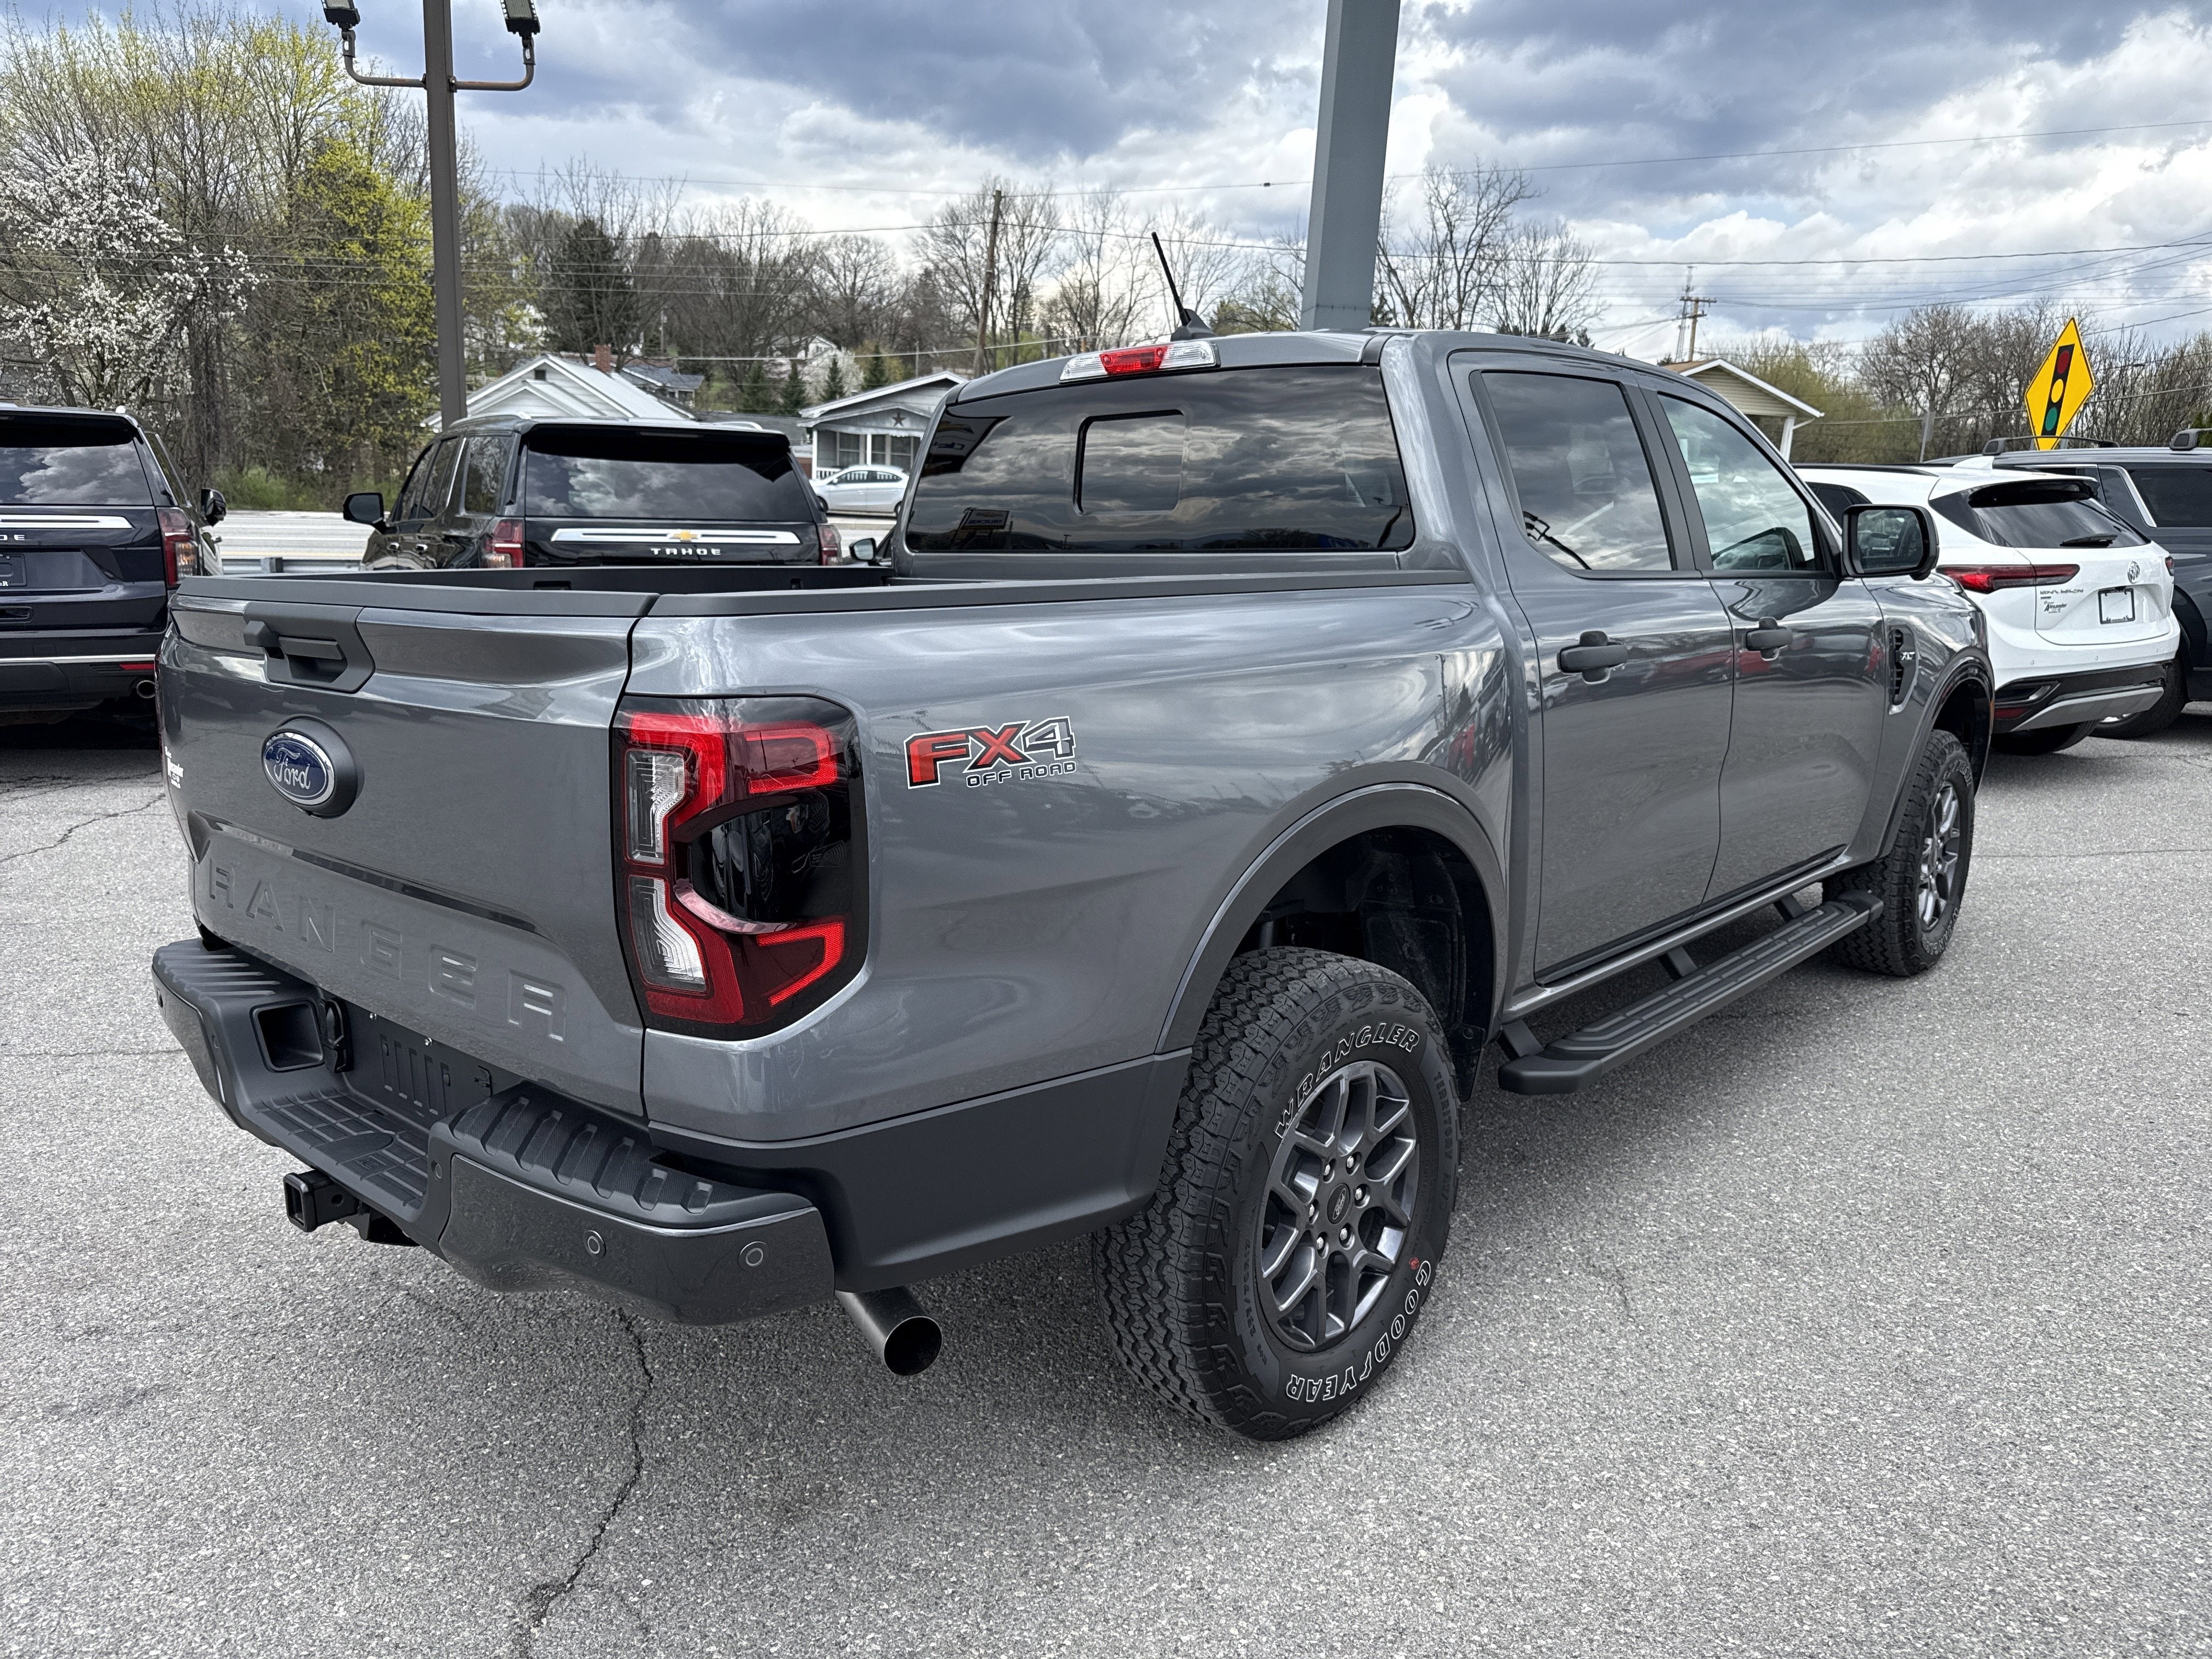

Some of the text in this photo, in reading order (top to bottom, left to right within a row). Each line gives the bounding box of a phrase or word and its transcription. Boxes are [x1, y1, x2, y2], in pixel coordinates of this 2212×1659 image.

[650, 548, 721, 556] TAHOE
[273, 747, 311, 790] Ford
[903, 715, 1076, 789] FX4
[966, 760, 1077, 788] OFF ROAD
[208, 857, 567, 1042] RANGER
[1273, 1022, 1420, 1138] WRANGLER
[1286, 1260, 1431, 1402] GOODYEAR
